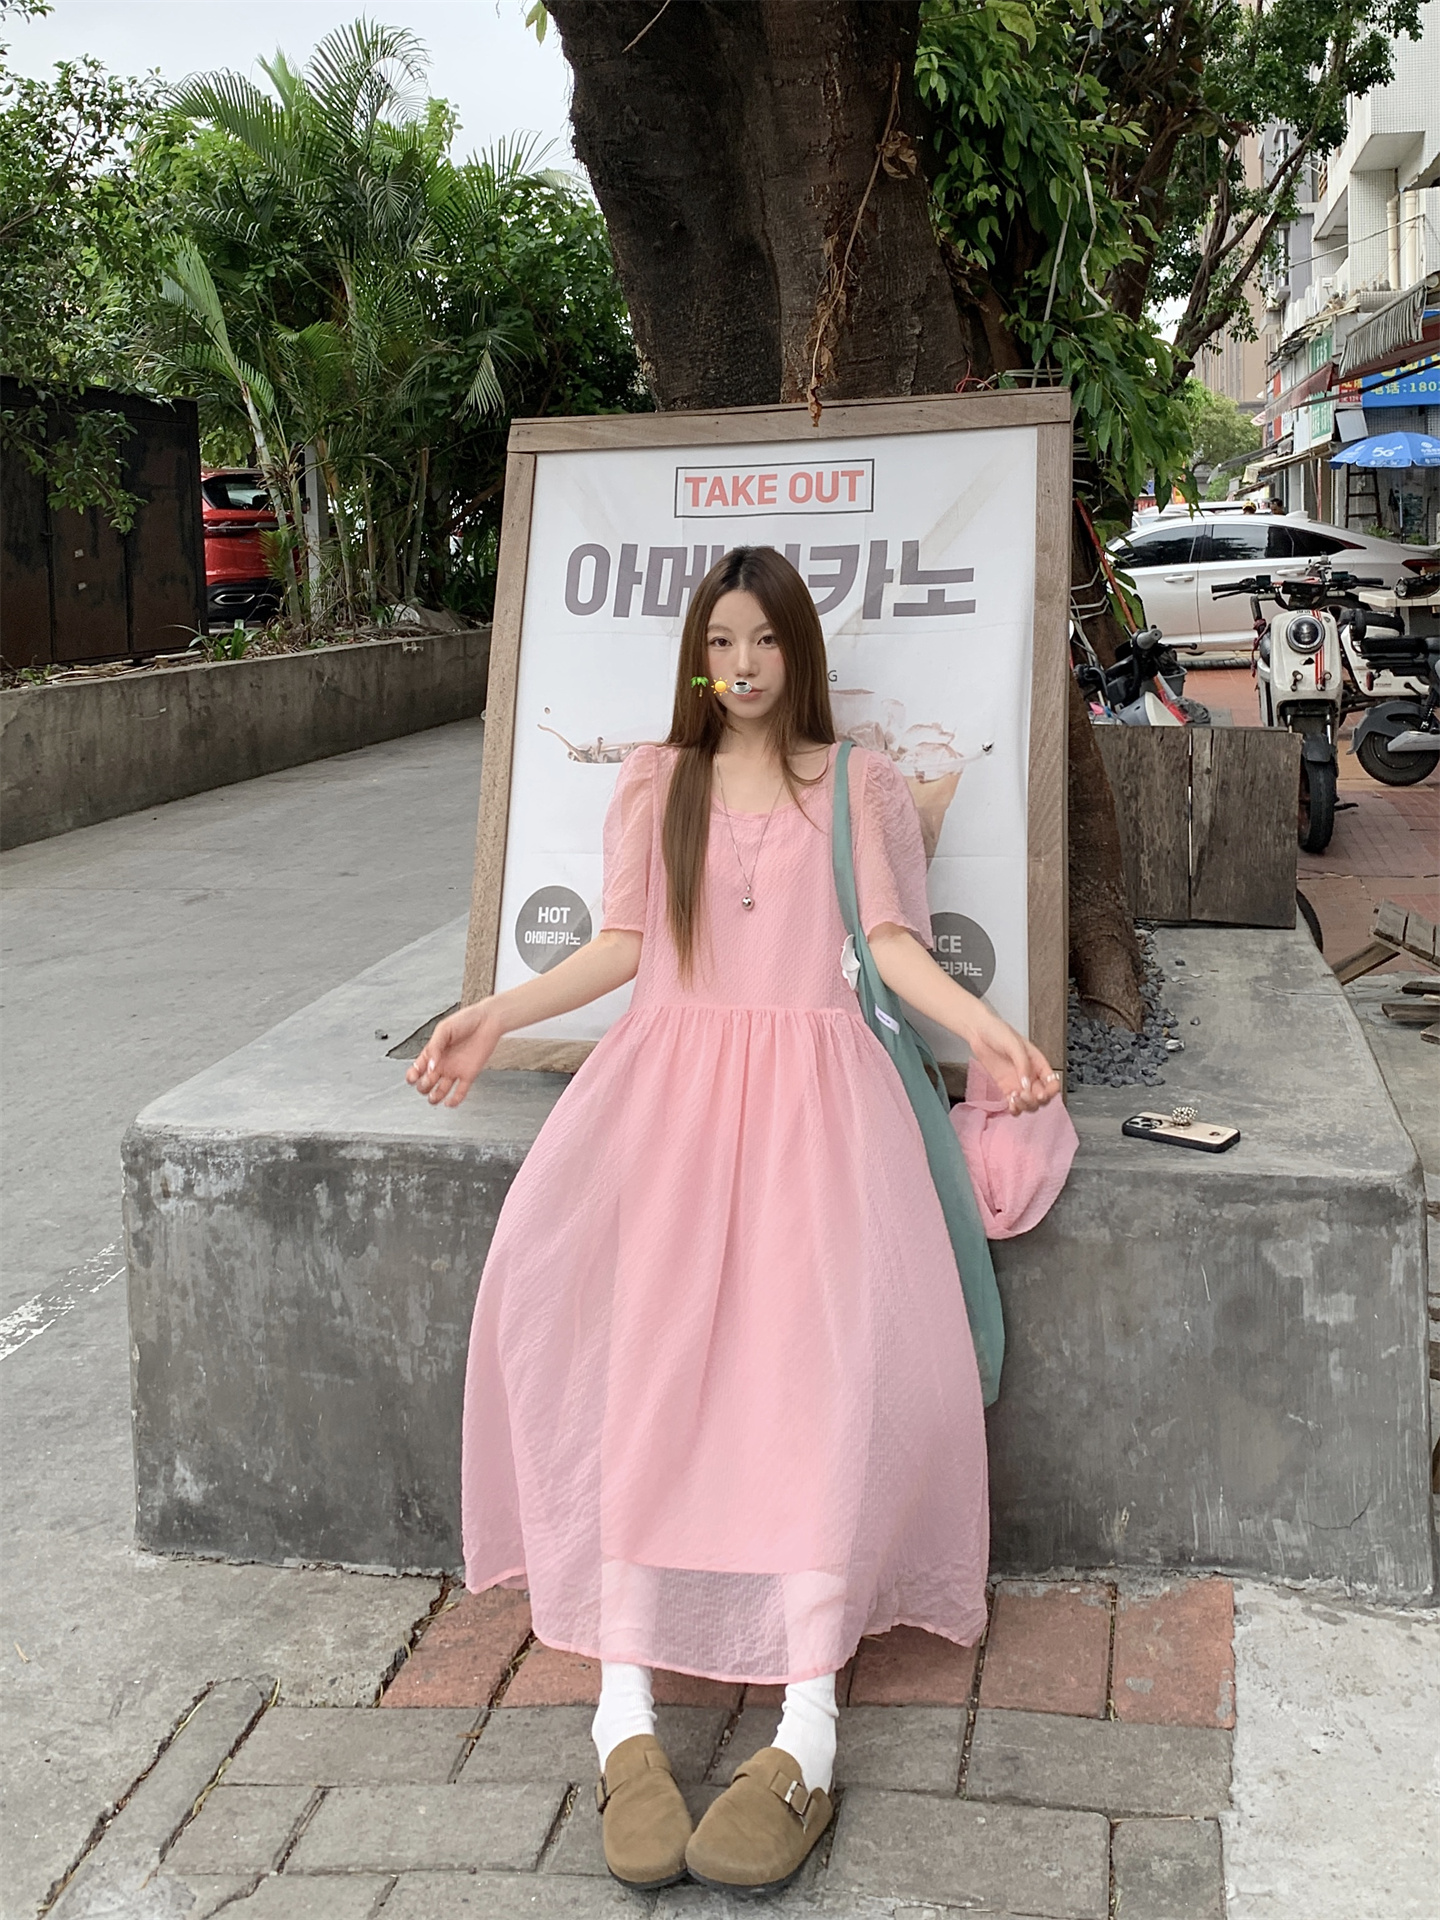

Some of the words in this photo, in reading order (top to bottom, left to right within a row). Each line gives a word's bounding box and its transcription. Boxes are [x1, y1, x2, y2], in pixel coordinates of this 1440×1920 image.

[684, 473, 778, 507] TAKE
[788, 469, 865, 504] OUT
[563, 539, 977, 620] 아메카노
[537, 906, 571, 924] HOT
[524, 930, 581, 946] 아메리카노
[933, 934, 962, 953] ICE
